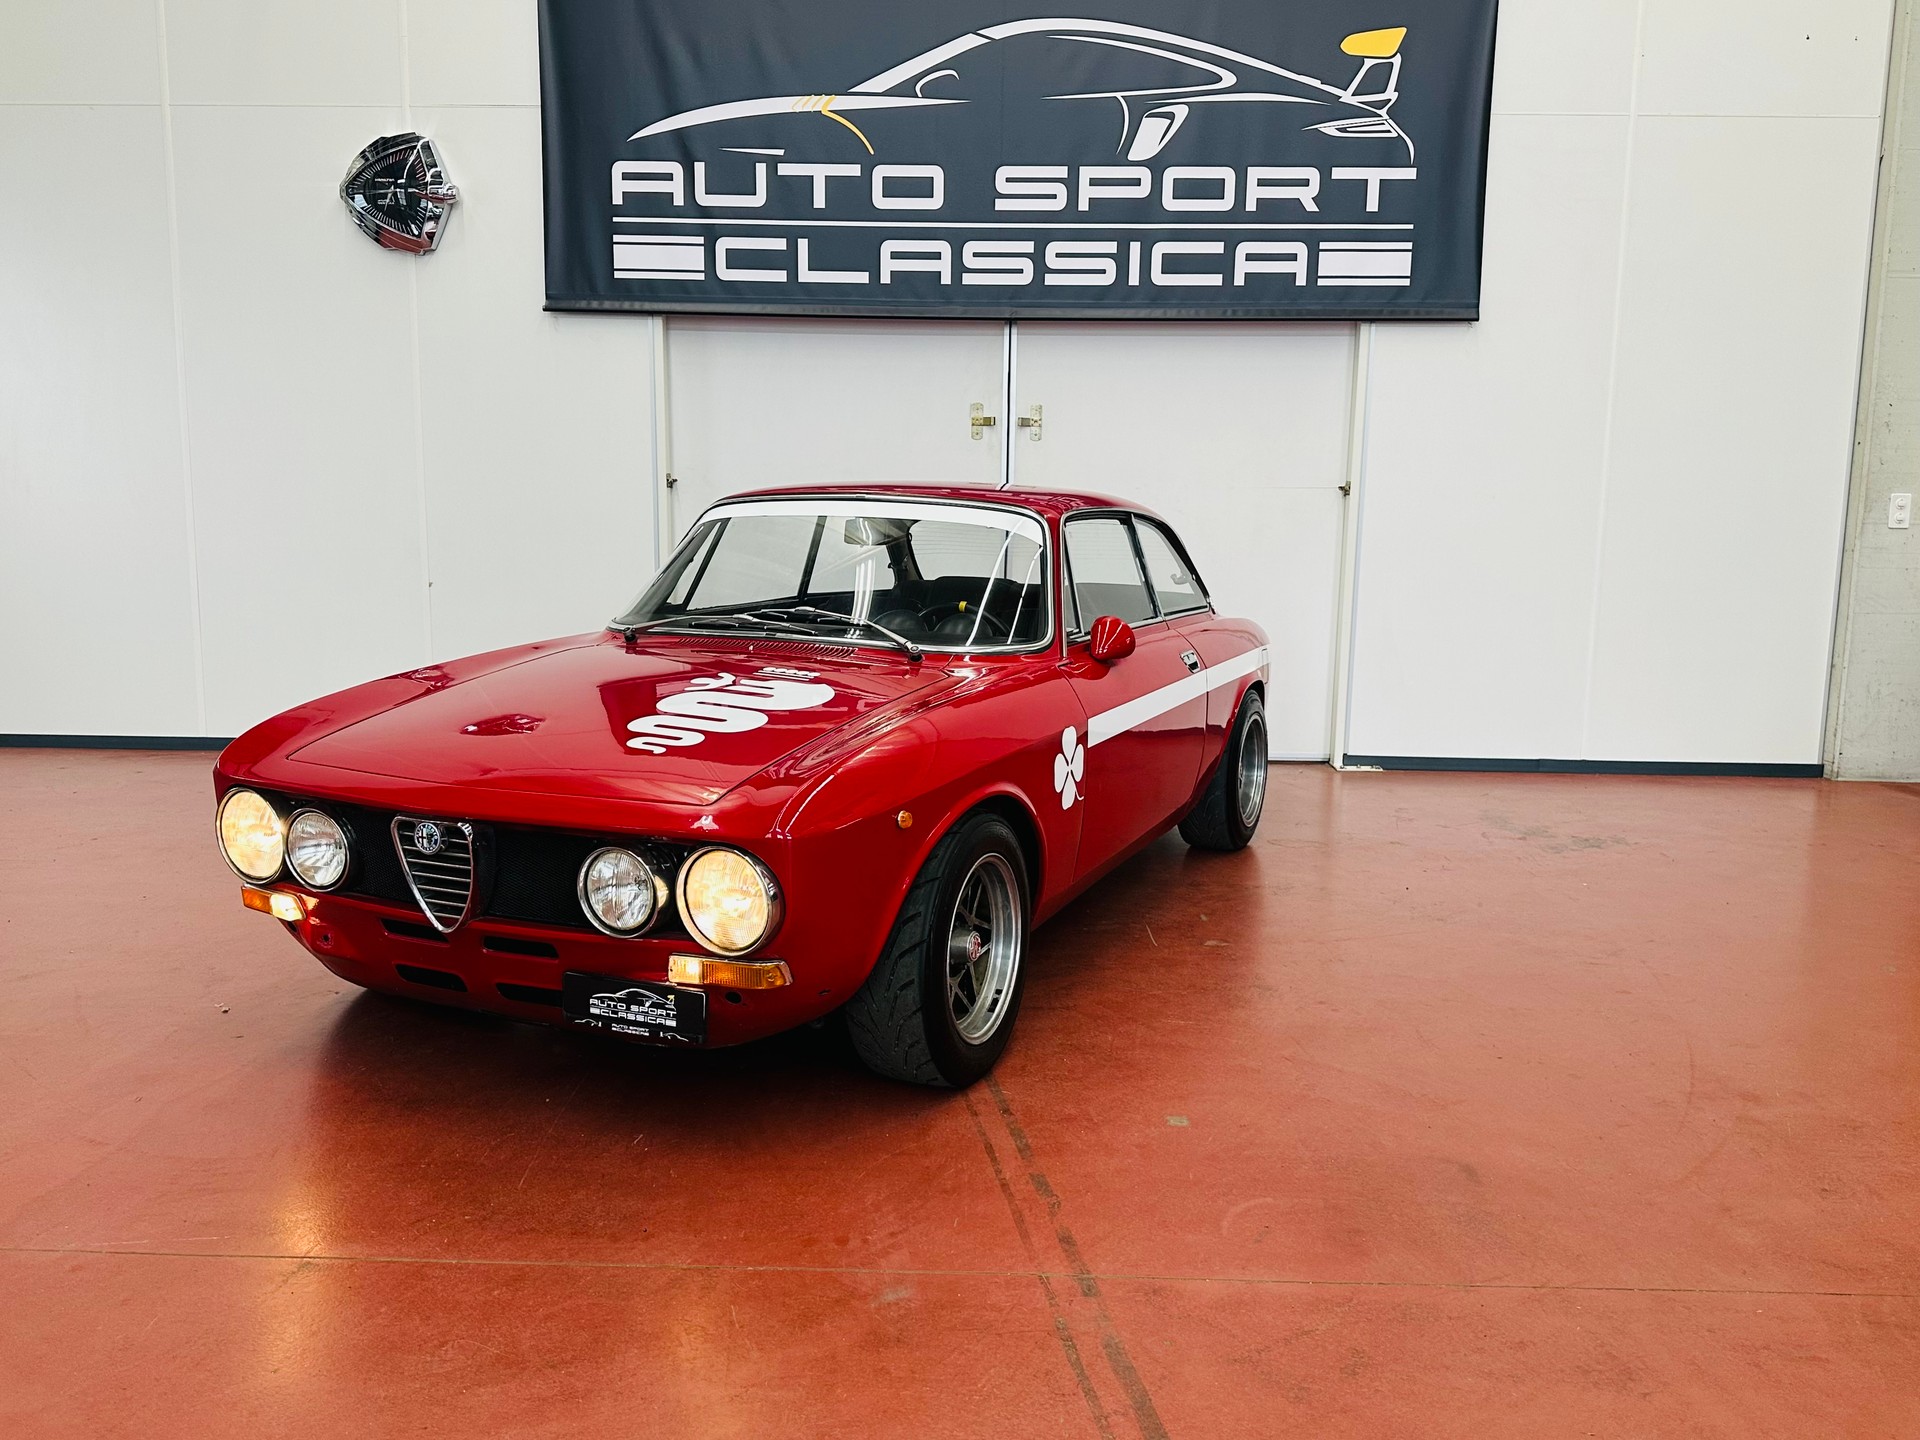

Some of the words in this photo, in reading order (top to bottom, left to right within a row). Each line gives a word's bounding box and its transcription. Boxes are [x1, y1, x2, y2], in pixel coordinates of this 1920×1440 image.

[611, 160, 945, 210] AUTO
[994, 165, 1418, 212] SPORT
[715, 236, 1309, 287] CLASSICA
[590, 999, 626, 1010] AUTO
[630, 1005, 677, 1017] SPORT
[600, 1009, 665, 1025] CLASSICA
